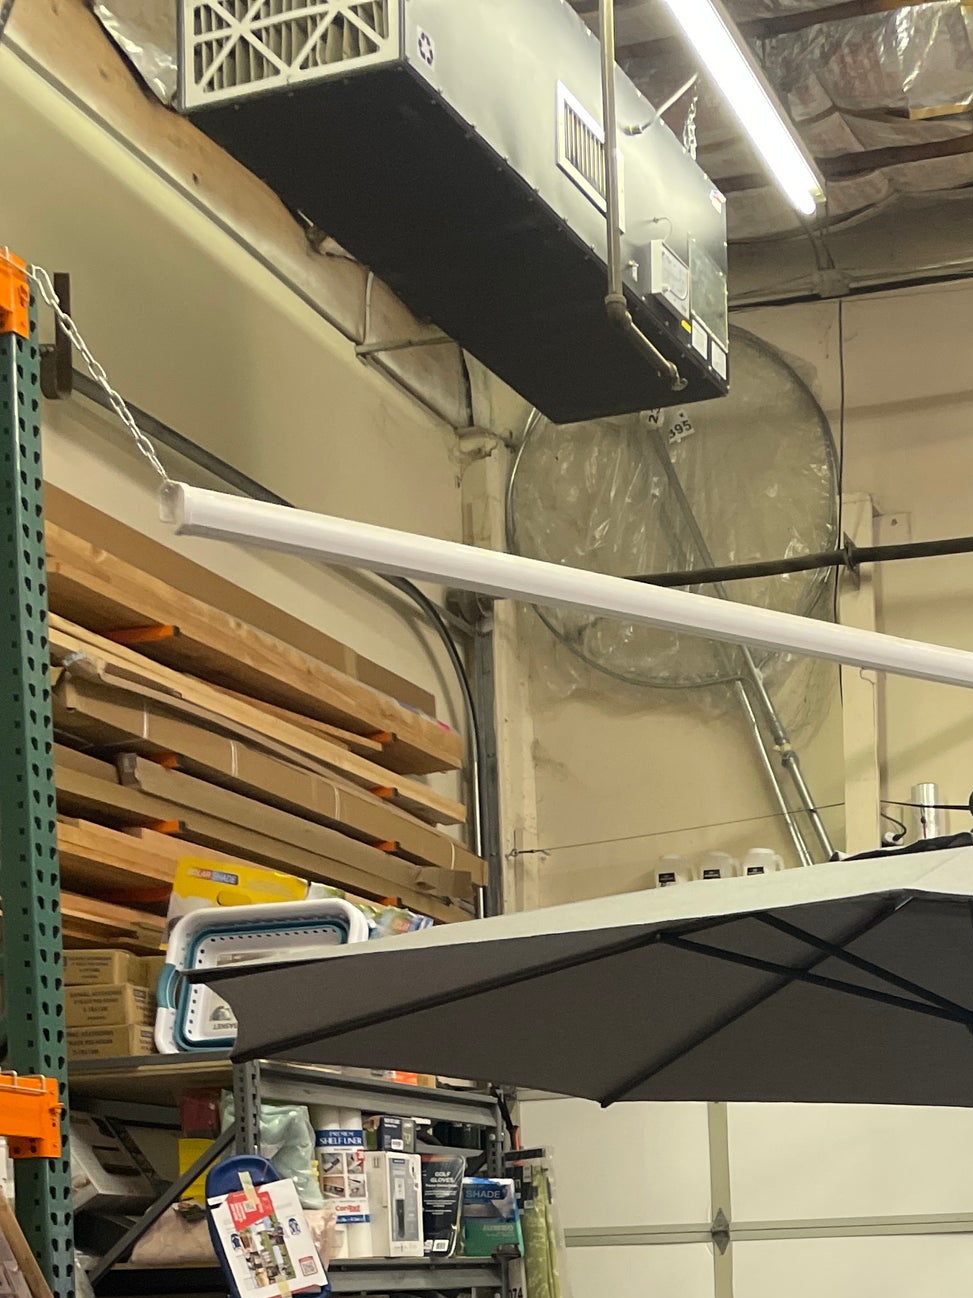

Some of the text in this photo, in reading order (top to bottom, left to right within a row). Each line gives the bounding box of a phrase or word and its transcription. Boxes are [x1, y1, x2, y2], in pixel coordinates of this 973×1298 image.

[319, 1137, 362, 1145] SHELF LINER
[464, 1189, 501, 1199] SHADE
